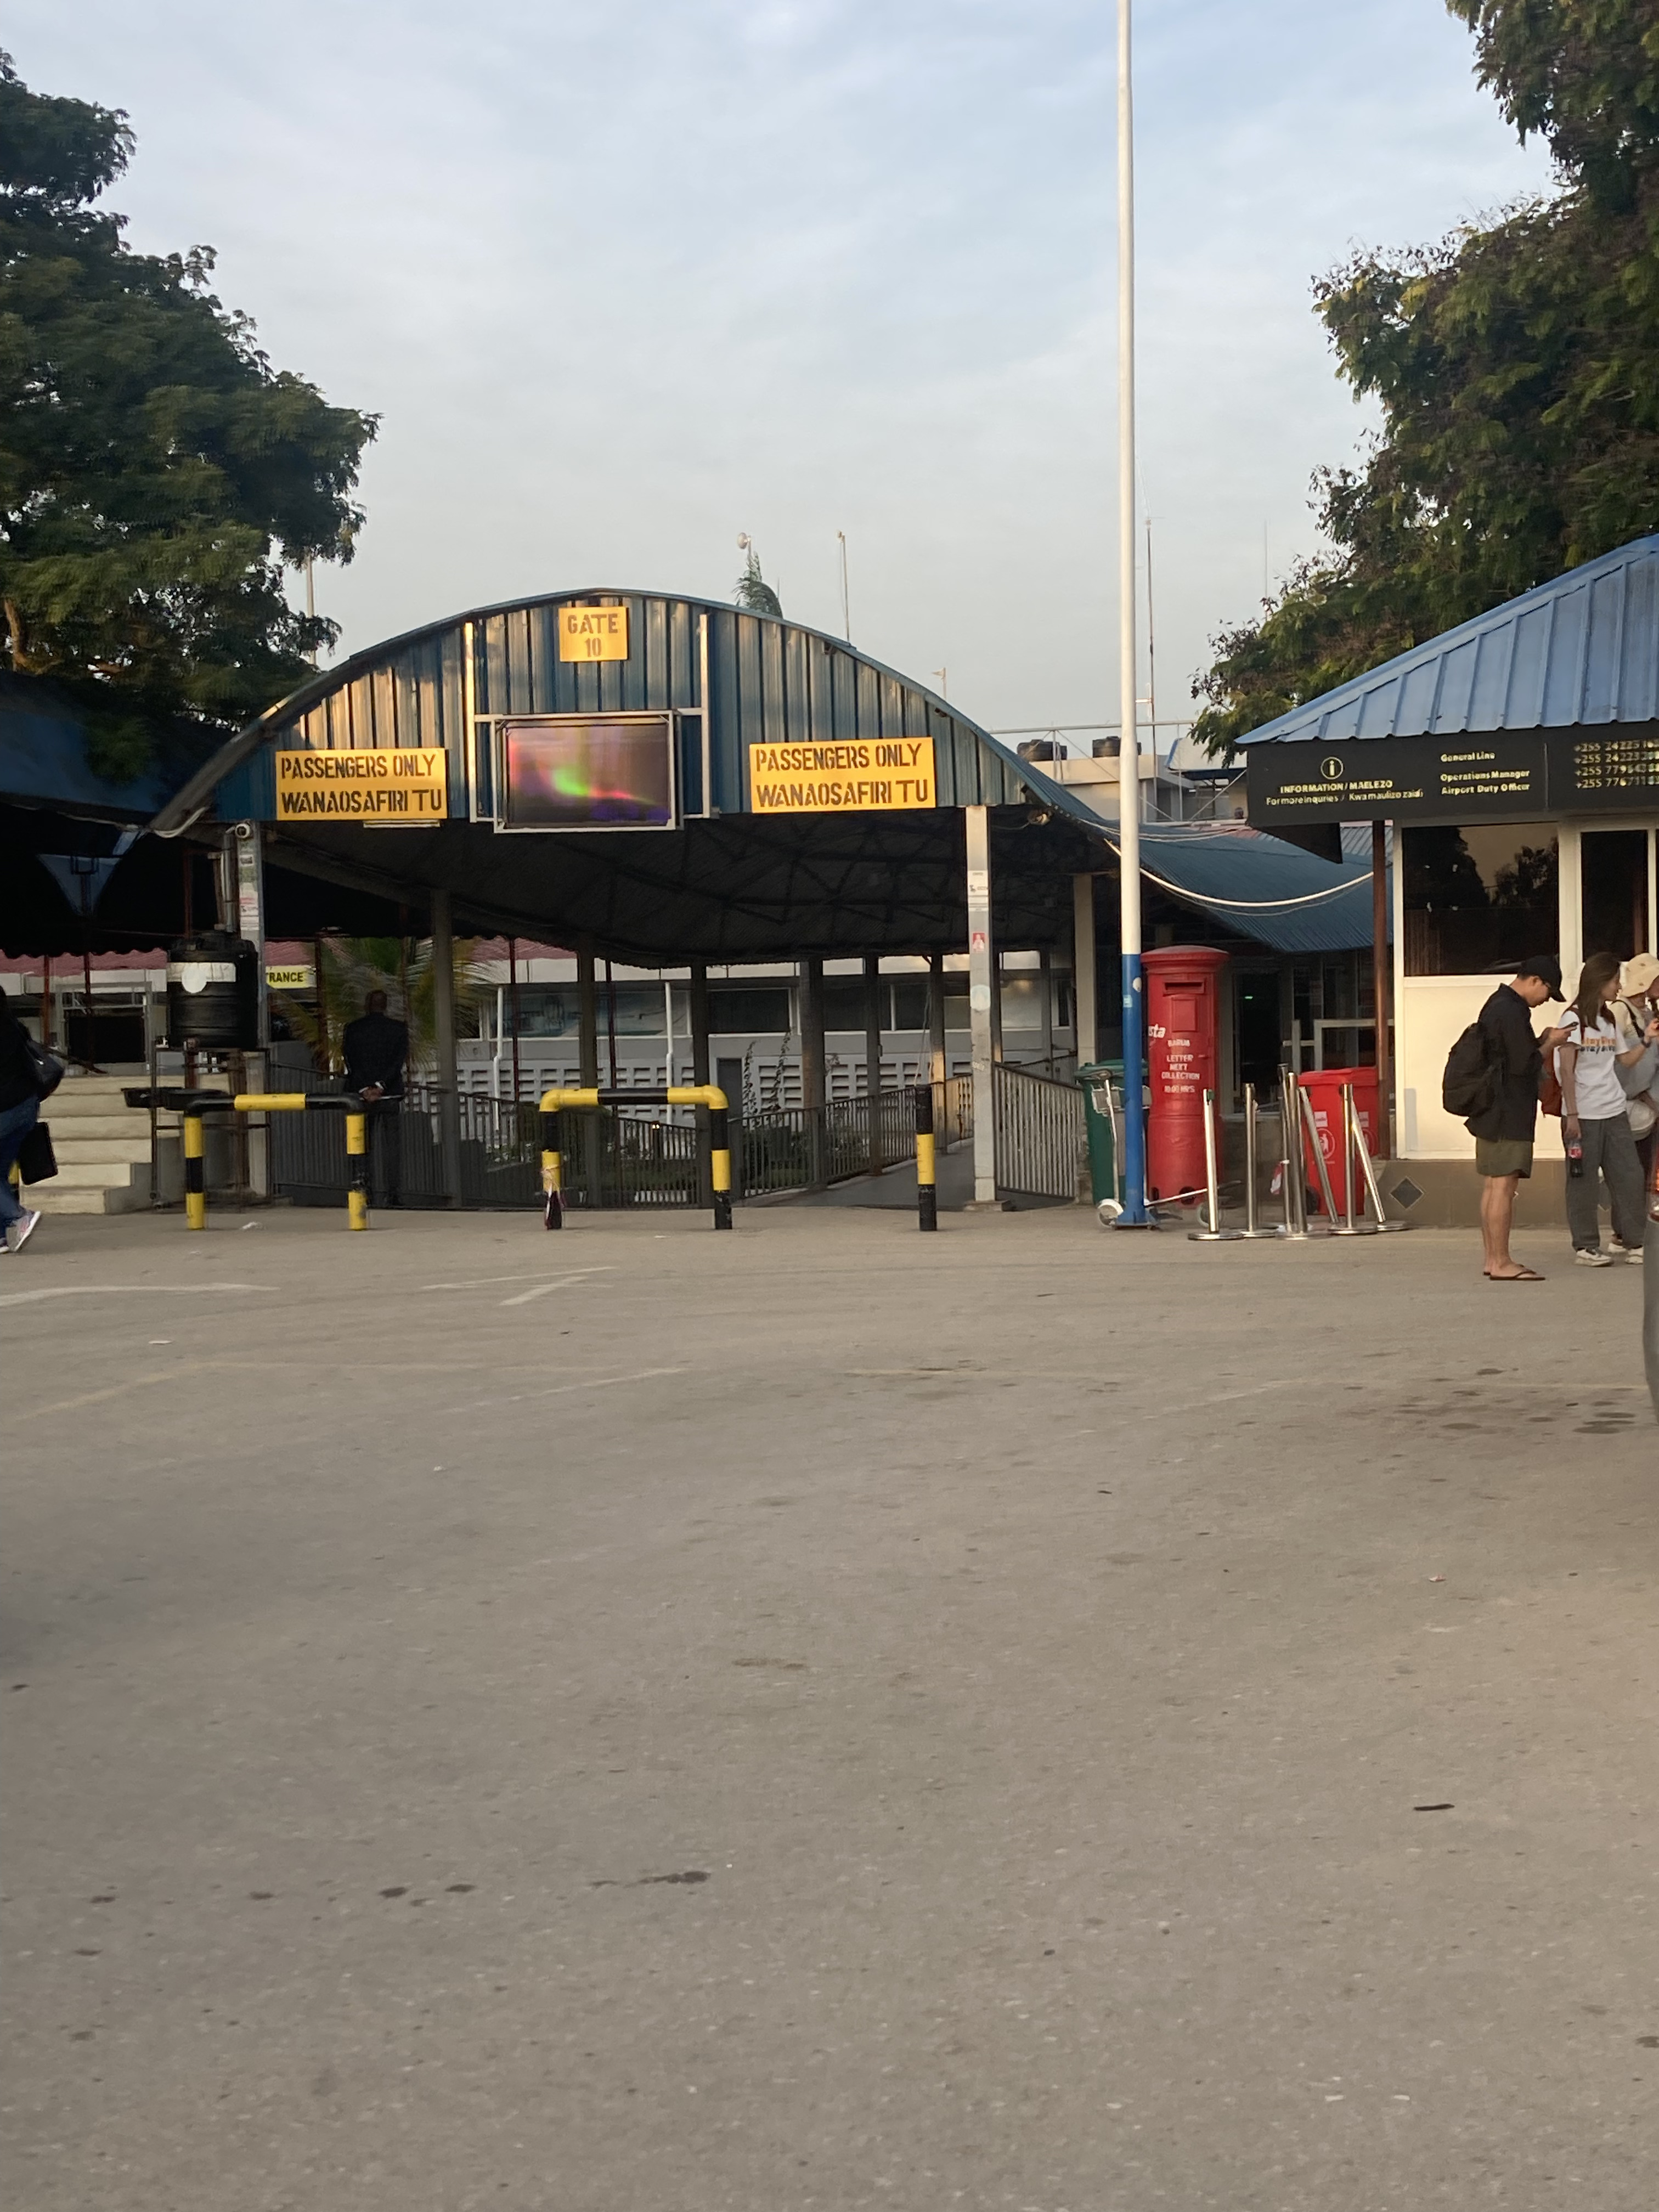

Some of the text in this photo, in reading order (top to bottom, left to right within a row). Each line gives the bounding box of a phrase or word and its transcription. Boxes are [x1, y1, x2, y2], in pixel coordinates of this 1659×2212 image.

[567, 613, 618, 634] GATE
[585, 637, 601, 657] 10
[281, 754, 436, 779] PASSENGERS ONLY
[755, 743, 922, 772] PASSENGERS ONLY
[1440, 751, 1496, 762] General Line
[1491, 770, 1530, 779] Manager
[756, 779, 928, 808] WANAOSAFIRI TU
[1280, 783, 1344, 793] INFORMATION
[1349, 780, 1393, 789] MAELEZO
[1441, 786, 1475, 795] Airport
[1477, 785, 1499, 793] Duty
[281, 789, 442, 813] WANAOSAFIRI TU
[267, 972, 304, 982] RANCE
